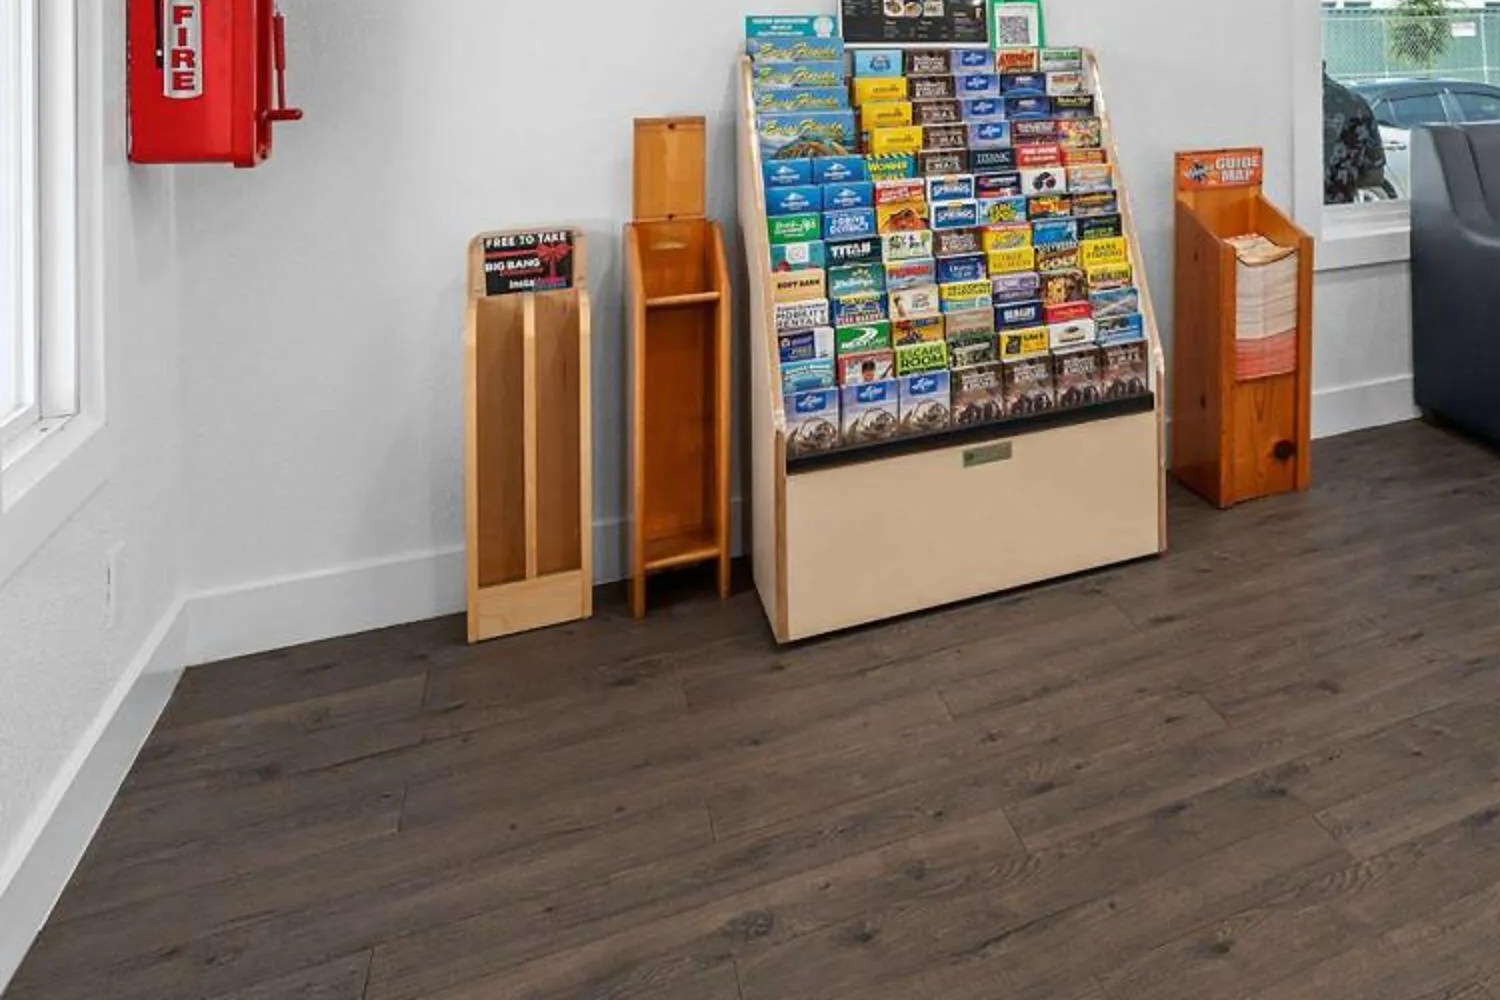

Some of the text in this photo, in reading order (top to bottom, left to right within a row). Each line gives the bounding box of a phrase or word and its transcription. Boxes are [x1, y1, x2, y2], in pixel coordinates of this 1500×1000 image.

[172, 5, 195, 91] FIRE
[1215, 156, 1259, 170] GUIDE
[1221, 169, 1254, 182] MAP
[486, 232, 567, 249] FREE TO TAKE
[485, 258, 540, 271] BIG BANG
[902, 353, 944, 368] ROOM
